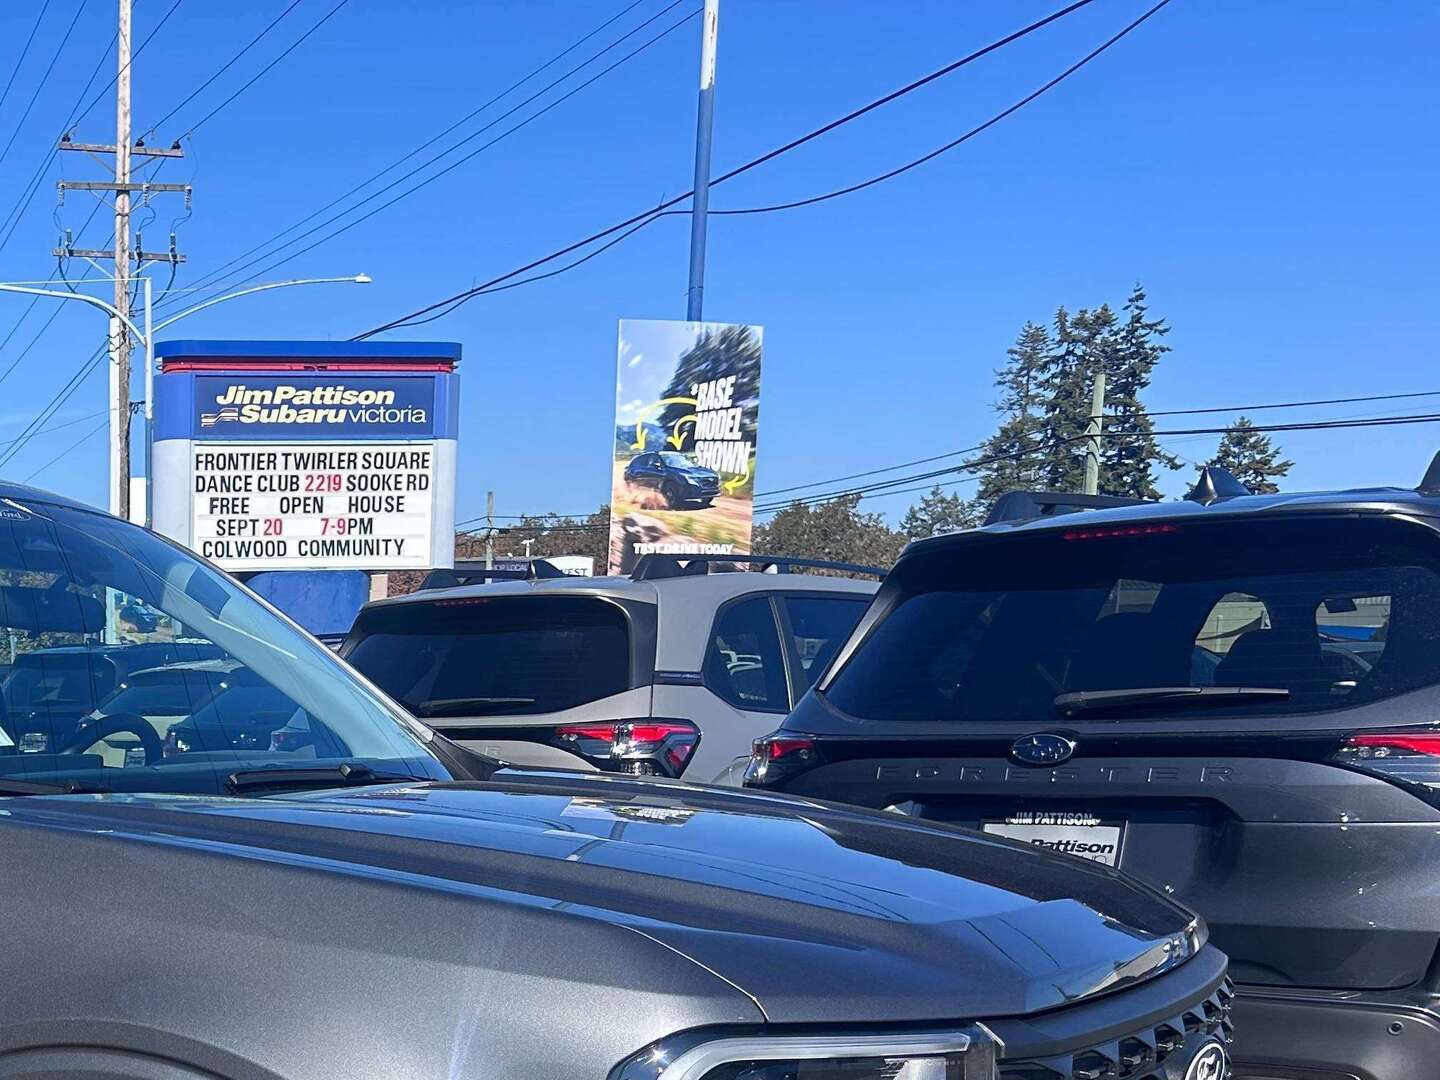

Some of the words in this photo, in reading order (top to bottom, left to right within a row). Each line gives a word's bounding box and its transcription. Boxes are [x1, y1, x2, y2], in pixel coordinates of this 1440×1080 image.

[272, 386, 395, 405] Pattison
[239, 405, 348, 424] Subaru
[348, 405, 427, 423] victoria
[694, 407, 742, 440] MODEL
[194, 453, 277, 471] FRONTIER
[281, 452, 358, 470] TWIRLER
[361, 451, 430, 470] SQUARE
[693, 440, 752, 475] SHOWN
[195, 475, 253, 493] DANCE
[257, 475, 300, 493] CLUB
[304, 475, 342, 492] 2219
[346, 474, 403, 492] SOOKE
[406, 474, 429, 491] RD
[209, 497, 250, 515] FREE
[279, 497, 324, 514] OPEN
[347, 496, 405, 513] HOUSE
[216, 519, 259, 537] SEPT
[263, 519, 283, 536] 20
[320, 518, 373, 535] 7-9PM
[202, 540, 287, 558] COLWOOD
[297, 539, 405, 557] COMMUNITY
[633, 543, 663, 554] TEST
[663, 543, 698, 554] DRIVE
[698, 543, 733, 555] TODAY
[874, 765, 1233, 783] FORESTER
[1034, 812, 1094, 825] PATTISON
